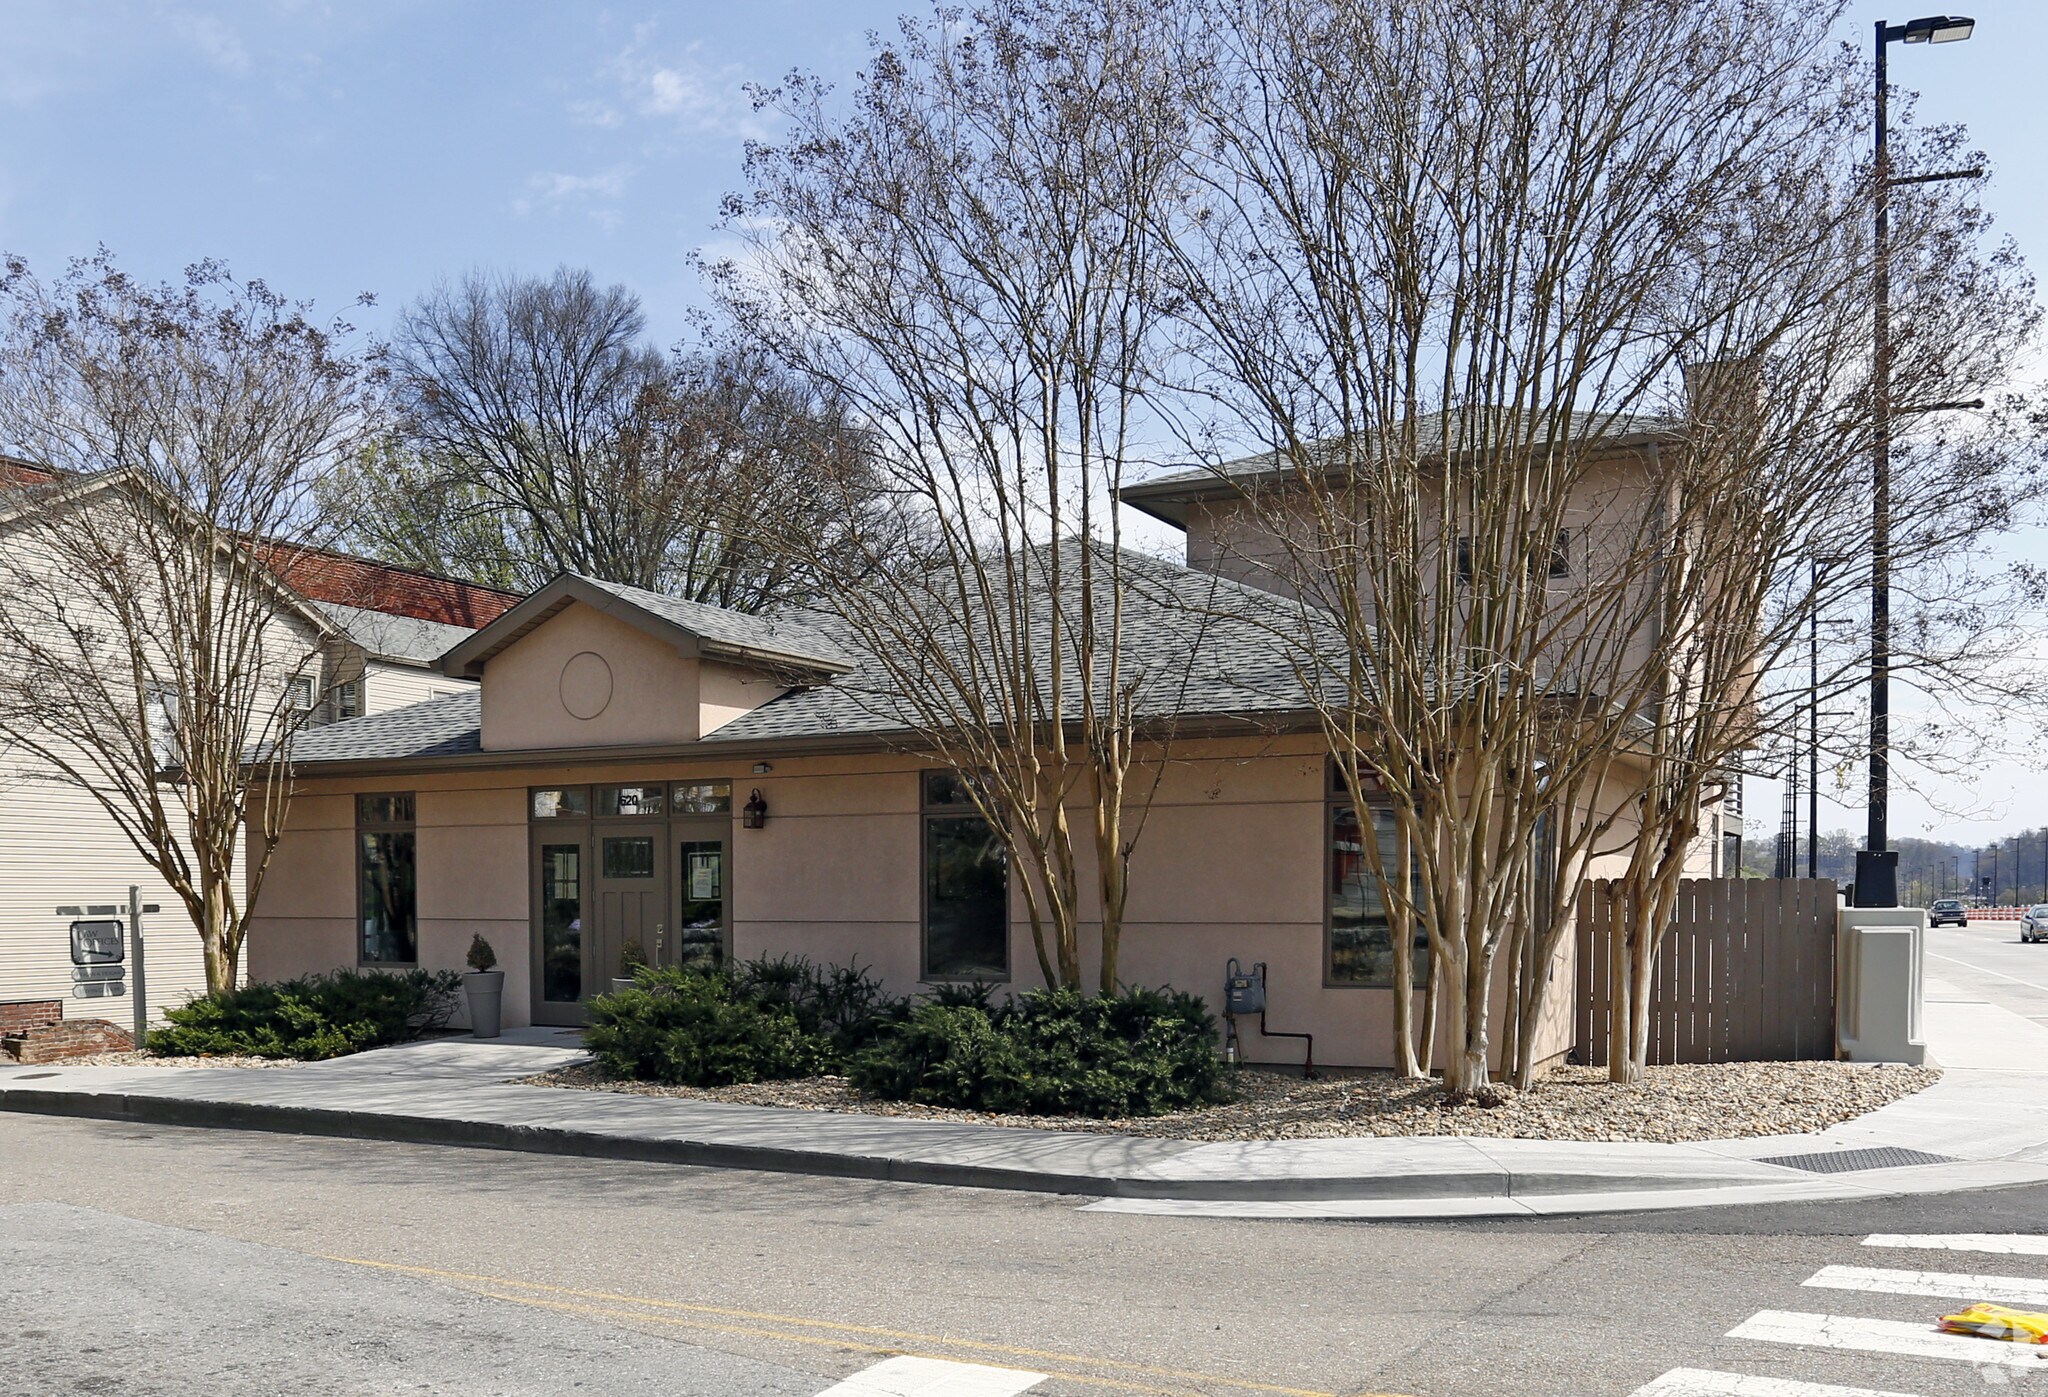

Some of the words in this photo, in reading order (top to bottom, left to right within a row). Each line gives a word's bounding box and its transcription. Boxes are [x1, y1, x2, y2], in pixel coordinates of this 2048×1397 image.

[620, 795, 638, 806] 620
[78, 930, 97, 940] LAW
[84, 937, 119, 948] OFFICES
